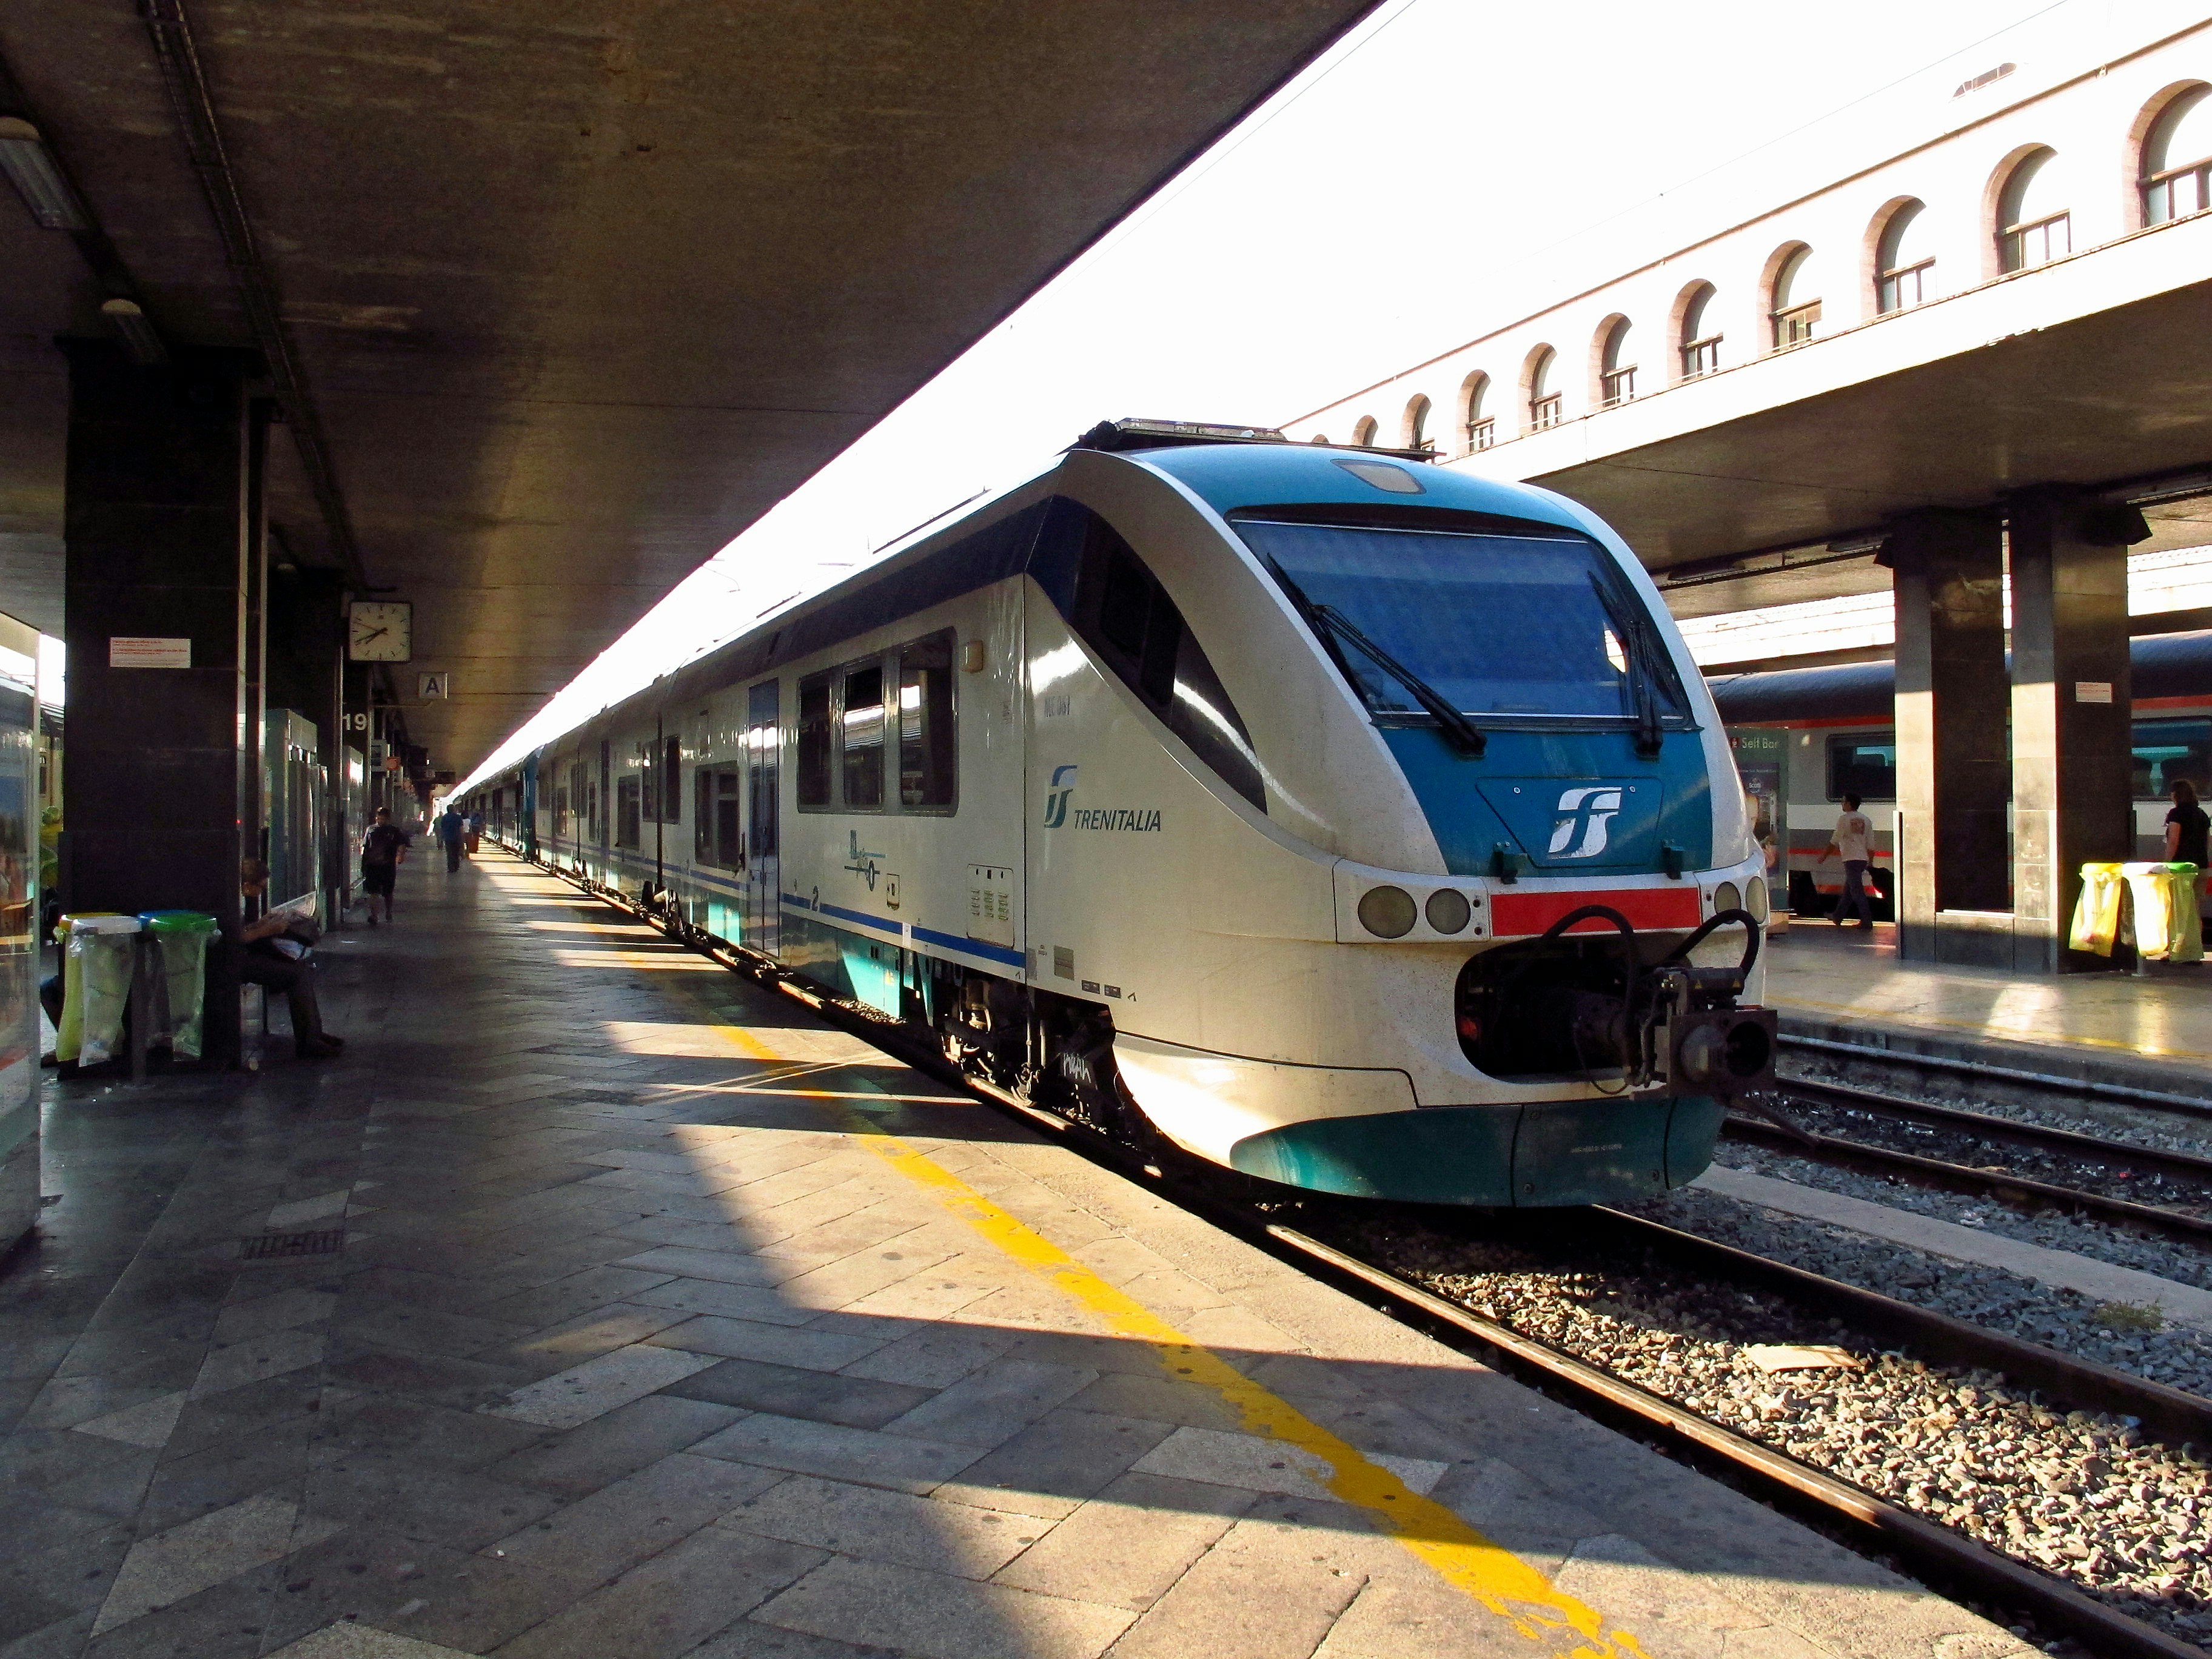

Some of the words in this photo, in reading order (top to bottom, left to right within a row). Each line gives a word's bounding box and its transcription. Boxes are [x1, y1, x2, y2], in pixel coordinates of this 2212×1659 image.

[426, 677, 440, 694] A
[343, 713, 367, 731] 19
[1741, 737, 1760, 749] Self
[1762, 737, 1778, 749] Bar
[1074, 809, 1162, 832] TRENITALIA
